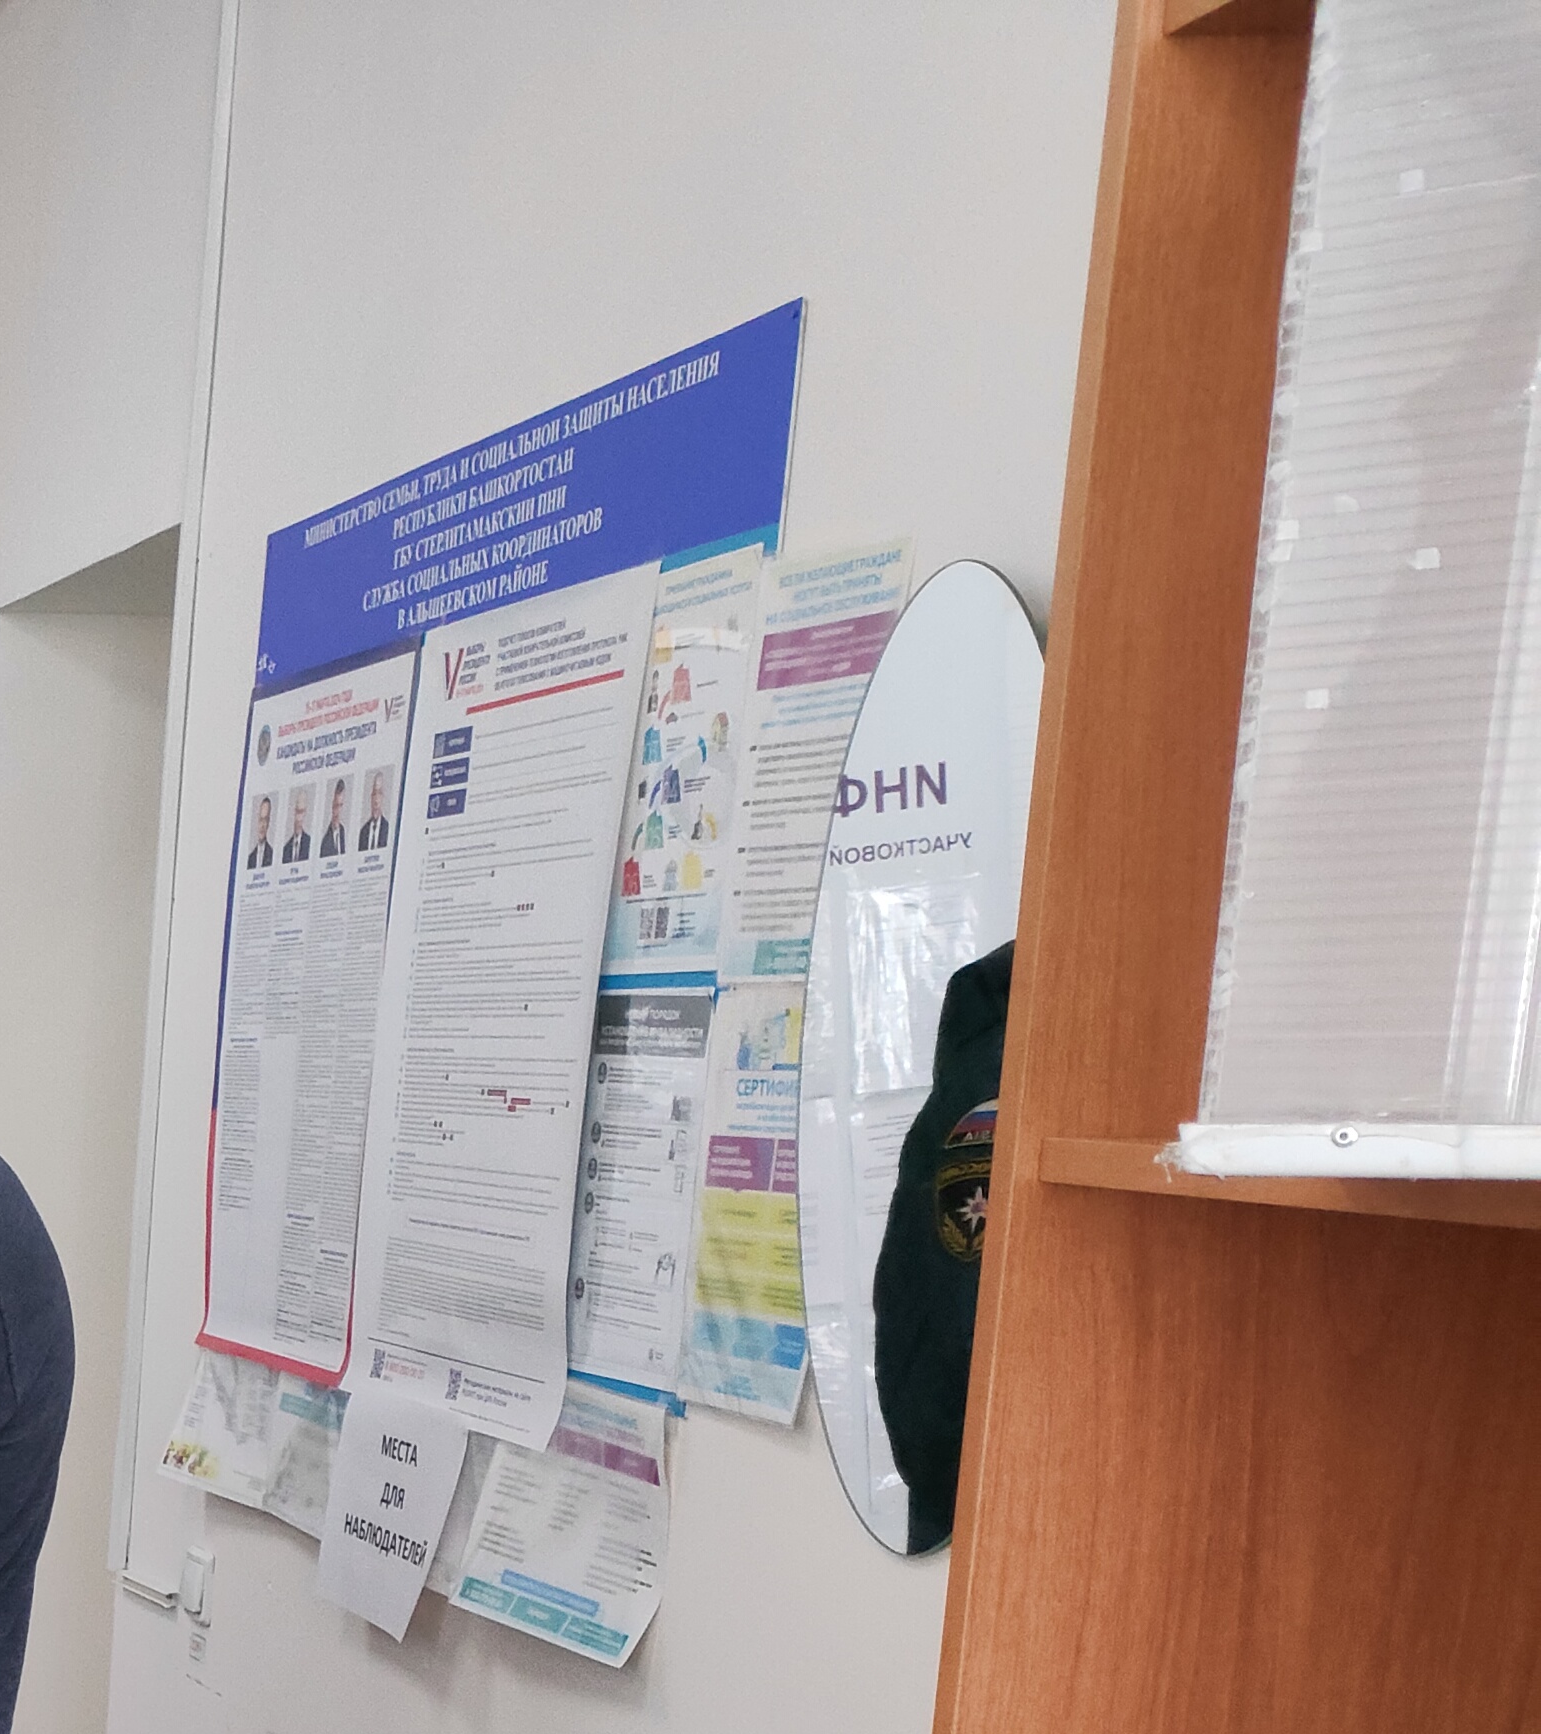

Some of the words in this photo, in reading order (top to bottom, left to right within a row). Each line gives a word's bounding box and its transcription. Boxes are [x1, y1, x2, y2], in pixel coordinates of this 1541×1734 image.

[304, 497, 381, 548] МИНИСТЕРСТВО
[423, 463, 457, 496] ТРУДА
[460, 456, 469, 480] И
[563, 392, 625, 439] ЗАЩИТЫ
[626, 351, 720, 415] НАСЕЛЕНИЯ
[393, 491, 466, 540] РЕСПУБЛИКИ
[469, 447, 574, 510] БАШКОРТОСТАН
[393, 545, 412, 570] ГБУ
[537, 485, 566, 517] ПНИ
[363, 580, 405, 612] СЛУЖБА
[407, 551, 488, 599] СОЦИАЛЬНЫХ
[491, 507, 603, 567] КООРДИНАТОРОВ
[397, 609, 405, 630] В
[407, 576, 498, 627] АЛЬШЕЕВСКОМ
[498, 560, 549, 598] РАЙОНЕ
[737, 1078, 799, 1098] СЕРТИФИ
[381, 1434, 417, 1467] МЕСТА
[380, 1482, 405, 1510] ДЛЯ
[344, 1512, 428, 1569] НАБЛЮДАТЕЛЕЙ
